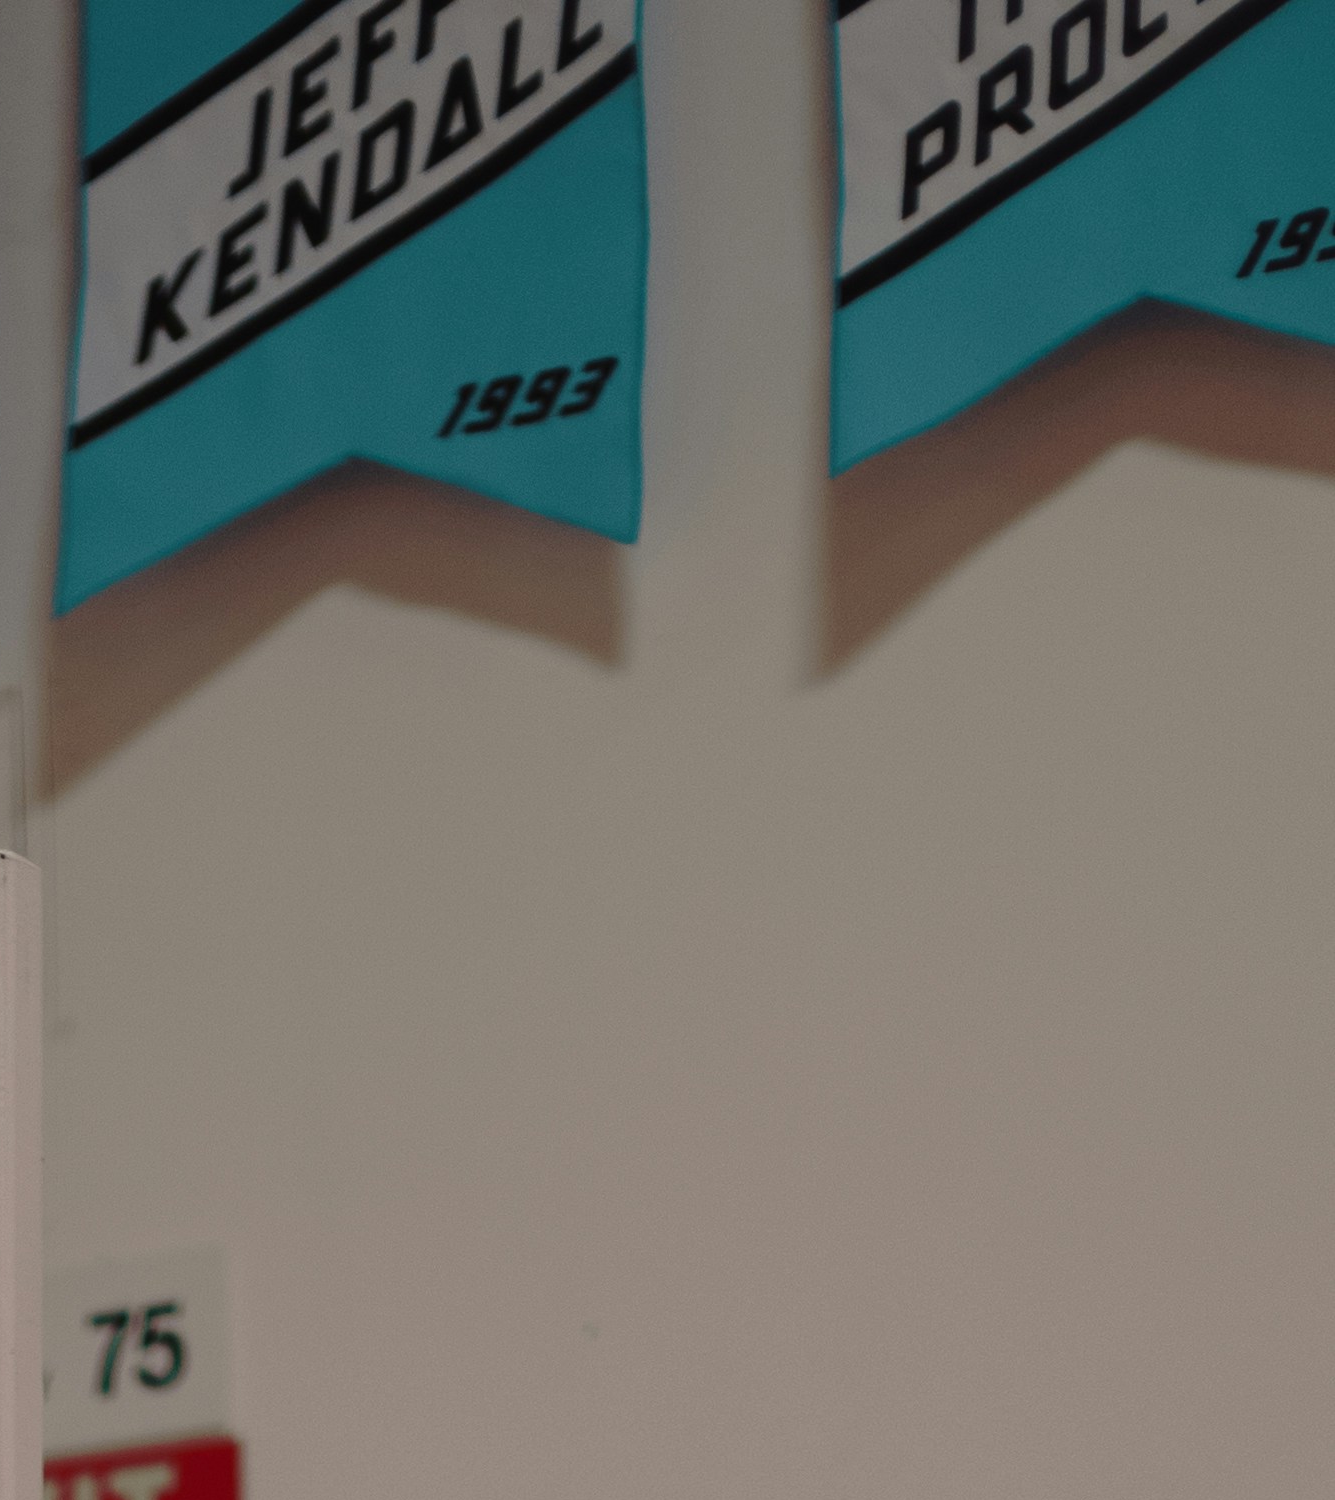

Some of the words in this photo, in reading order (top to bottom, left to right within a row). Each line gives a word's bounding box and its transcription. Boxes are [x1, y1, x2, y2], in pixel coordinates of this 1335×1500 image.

[135, 0, 604, 366] KENDALL
[436, 356, 619, 439] 1993
[86, 1301, 186, 1397] 75
